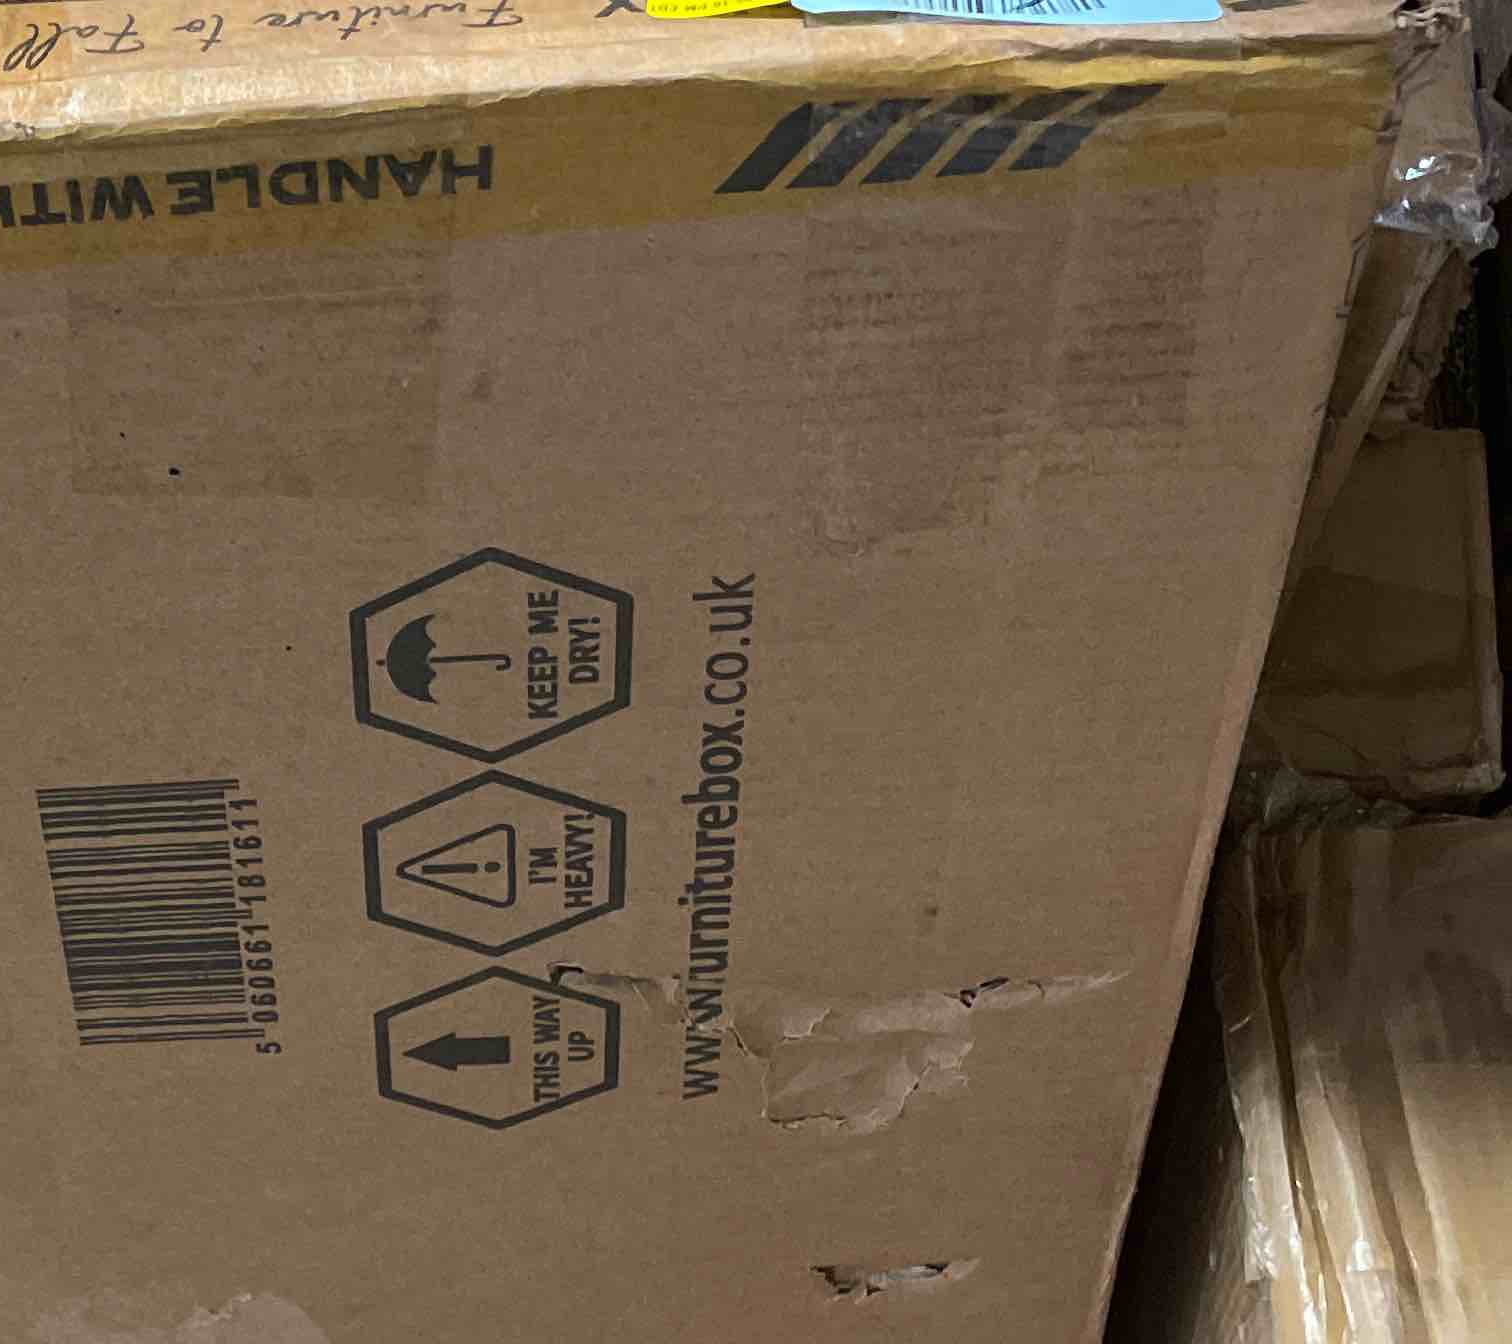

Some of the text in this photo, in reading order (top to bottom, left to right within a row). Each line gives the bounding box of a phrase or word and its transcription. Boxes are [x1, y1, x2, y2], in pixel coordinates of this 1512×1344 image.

[3, 13, 146, 73] Fall
[174, 13, 226, 51] to
[166, 144, 496, 218] HANDLE
[527, 587, 560, 720] KEEP ME
[567, 616, 601, 686] DRY!
[528, 845, 558, 887] I'M
[563, 810, 596, 909] HEAVY!
[533, 994, 562, 1104] THIS WAY
[567, 1031, 596, 1062] UP
